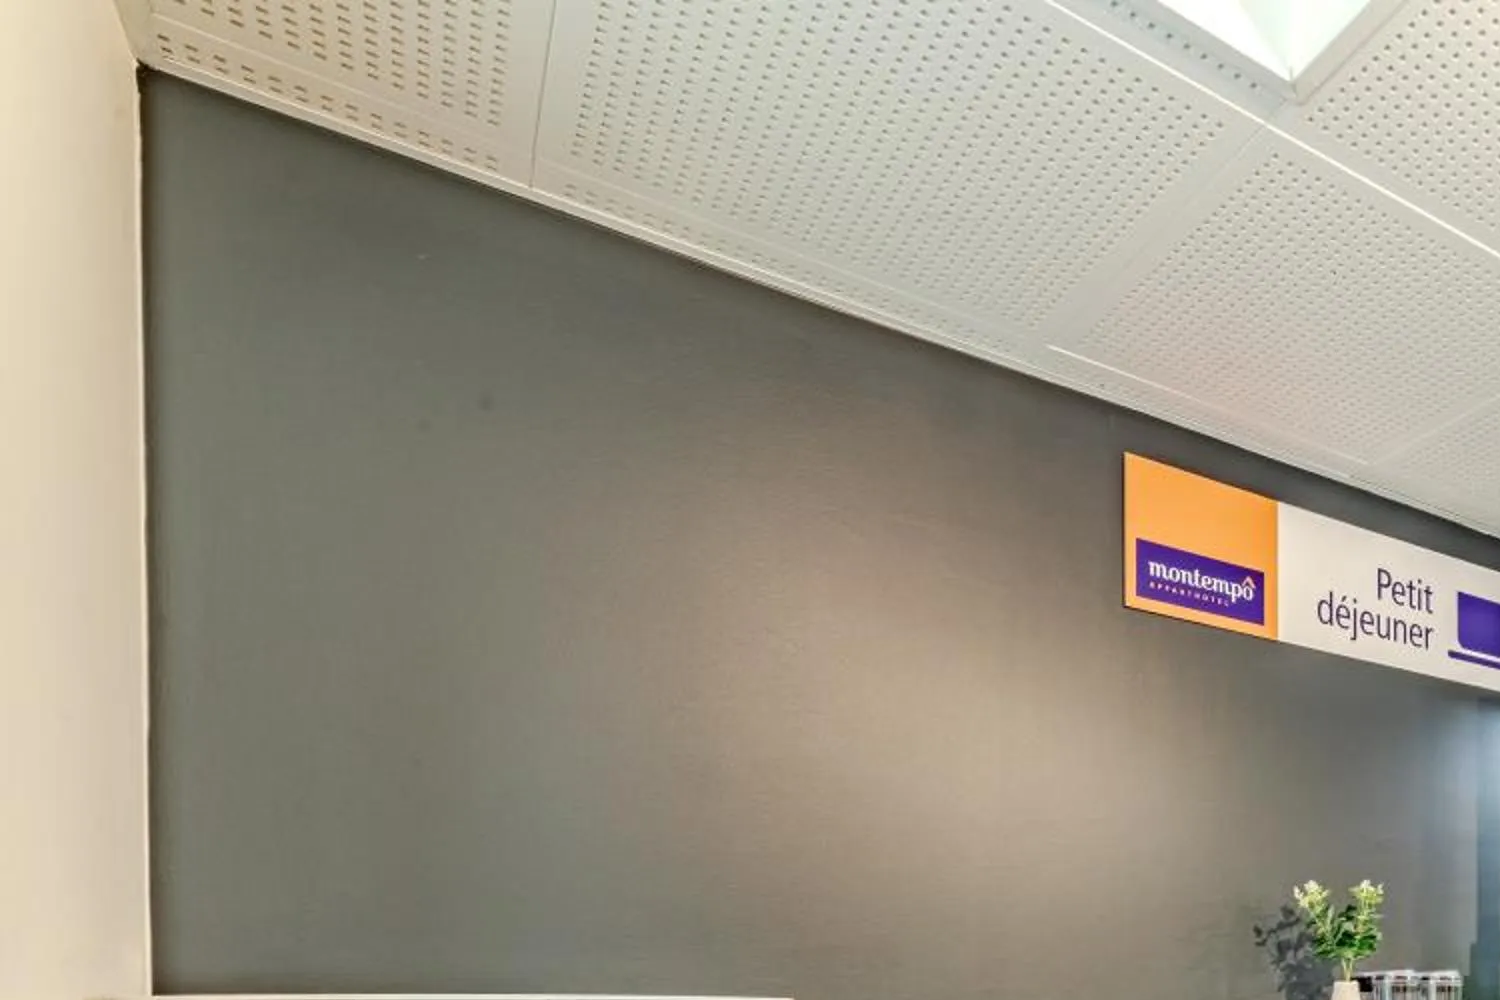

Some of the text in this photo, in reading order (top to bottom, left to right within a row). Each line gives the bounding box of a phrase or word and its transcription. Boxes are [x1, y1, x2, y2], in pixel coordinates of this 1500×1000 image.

[1148, 561, 1255, 603] montempô
[1377, 567, 1433, 614] Petit
[1317, 590, 1434, 650] déjeuner
